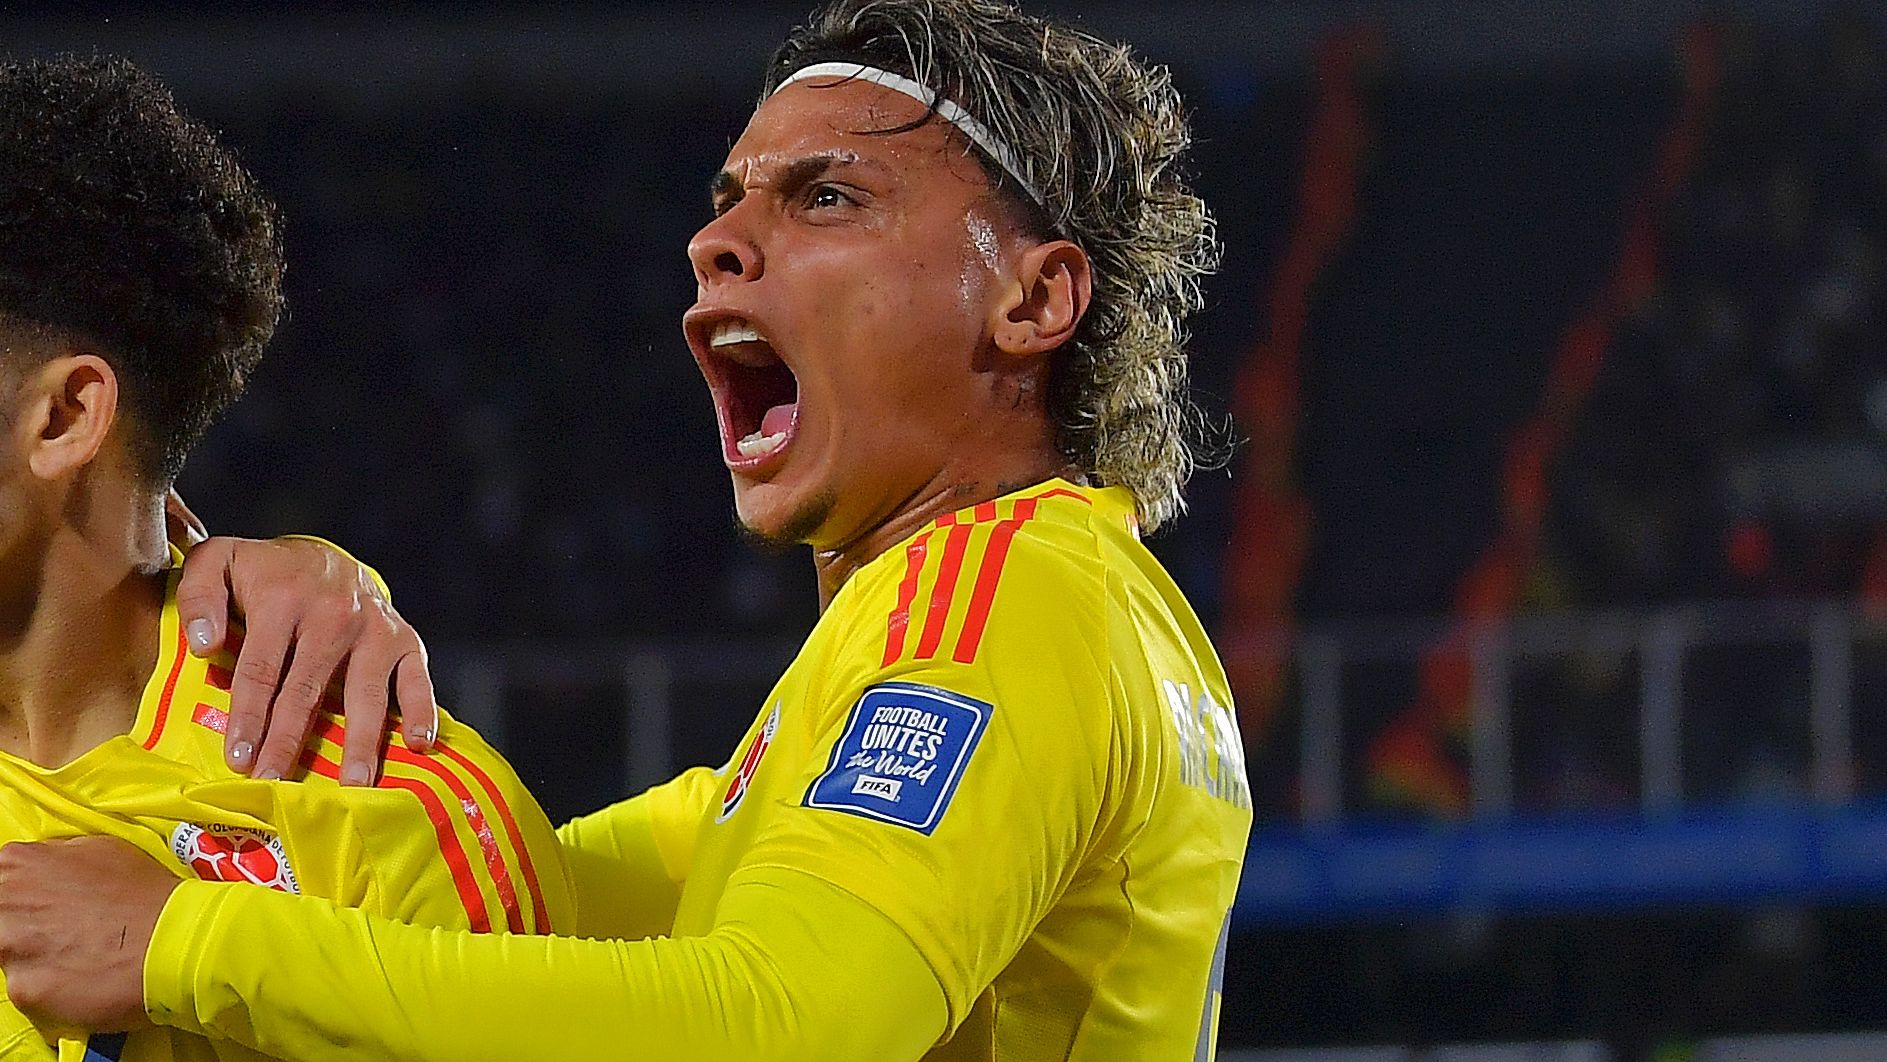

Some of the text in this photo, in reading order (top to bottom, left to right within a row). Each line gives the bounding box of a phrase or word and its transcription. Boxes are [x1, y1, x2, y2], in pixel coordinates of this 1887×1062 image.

[870, 706, 949, 736] FOOTBALL
[861, 723, 943, 761] UNITES
[874, 749, 938, 786] World
[860, 781, 891, 794] FIFA
